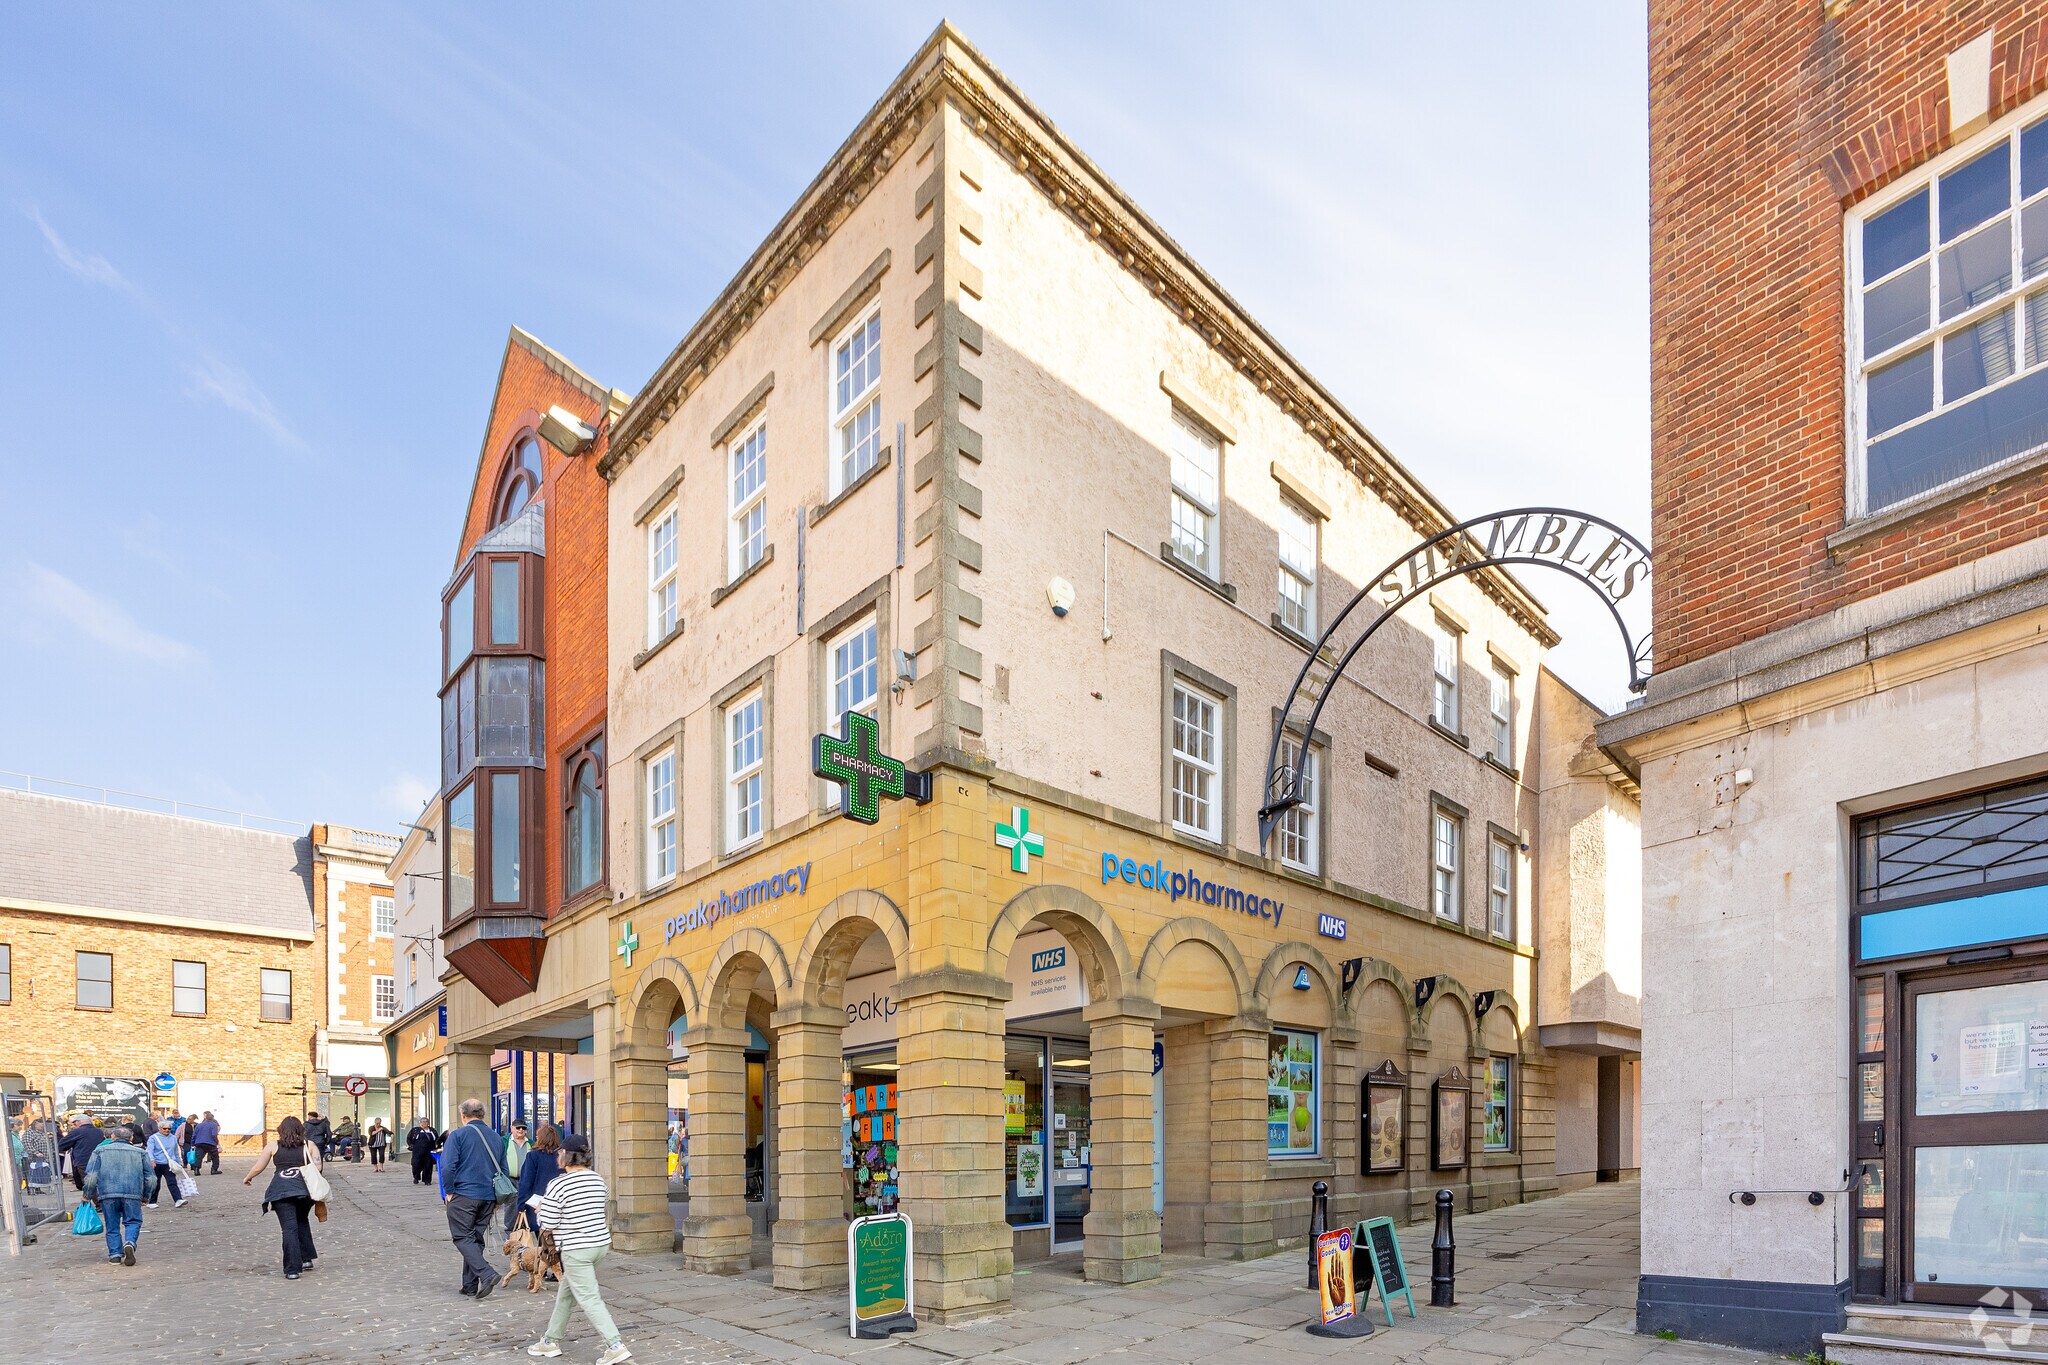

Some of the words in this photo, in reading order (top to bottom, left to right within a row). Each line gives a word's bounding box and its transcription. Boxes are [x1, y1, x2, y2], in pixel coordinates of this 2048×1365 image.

[1379, 515, 1652, 608] SHAMBLES
[833, 751, 894, 780] PHARMACY
[1102, 851, 1285, 928] peakpharmacy
[665, 862, 812, 946] peakpharmacy
[1320, 915, 1346, 938] NHS
[1034, 949, 1063, 970] NHS
[1030, 987, 1053, 996] available
[1031, 979, 1044, 987] NHS
[1045, 976, 1066, 985] services
[860, 1231, 903, 1248] Adorn
[1319, 1237, 1339, 1248] Curious
[1321, 1248, 1337, 1257] Goods
